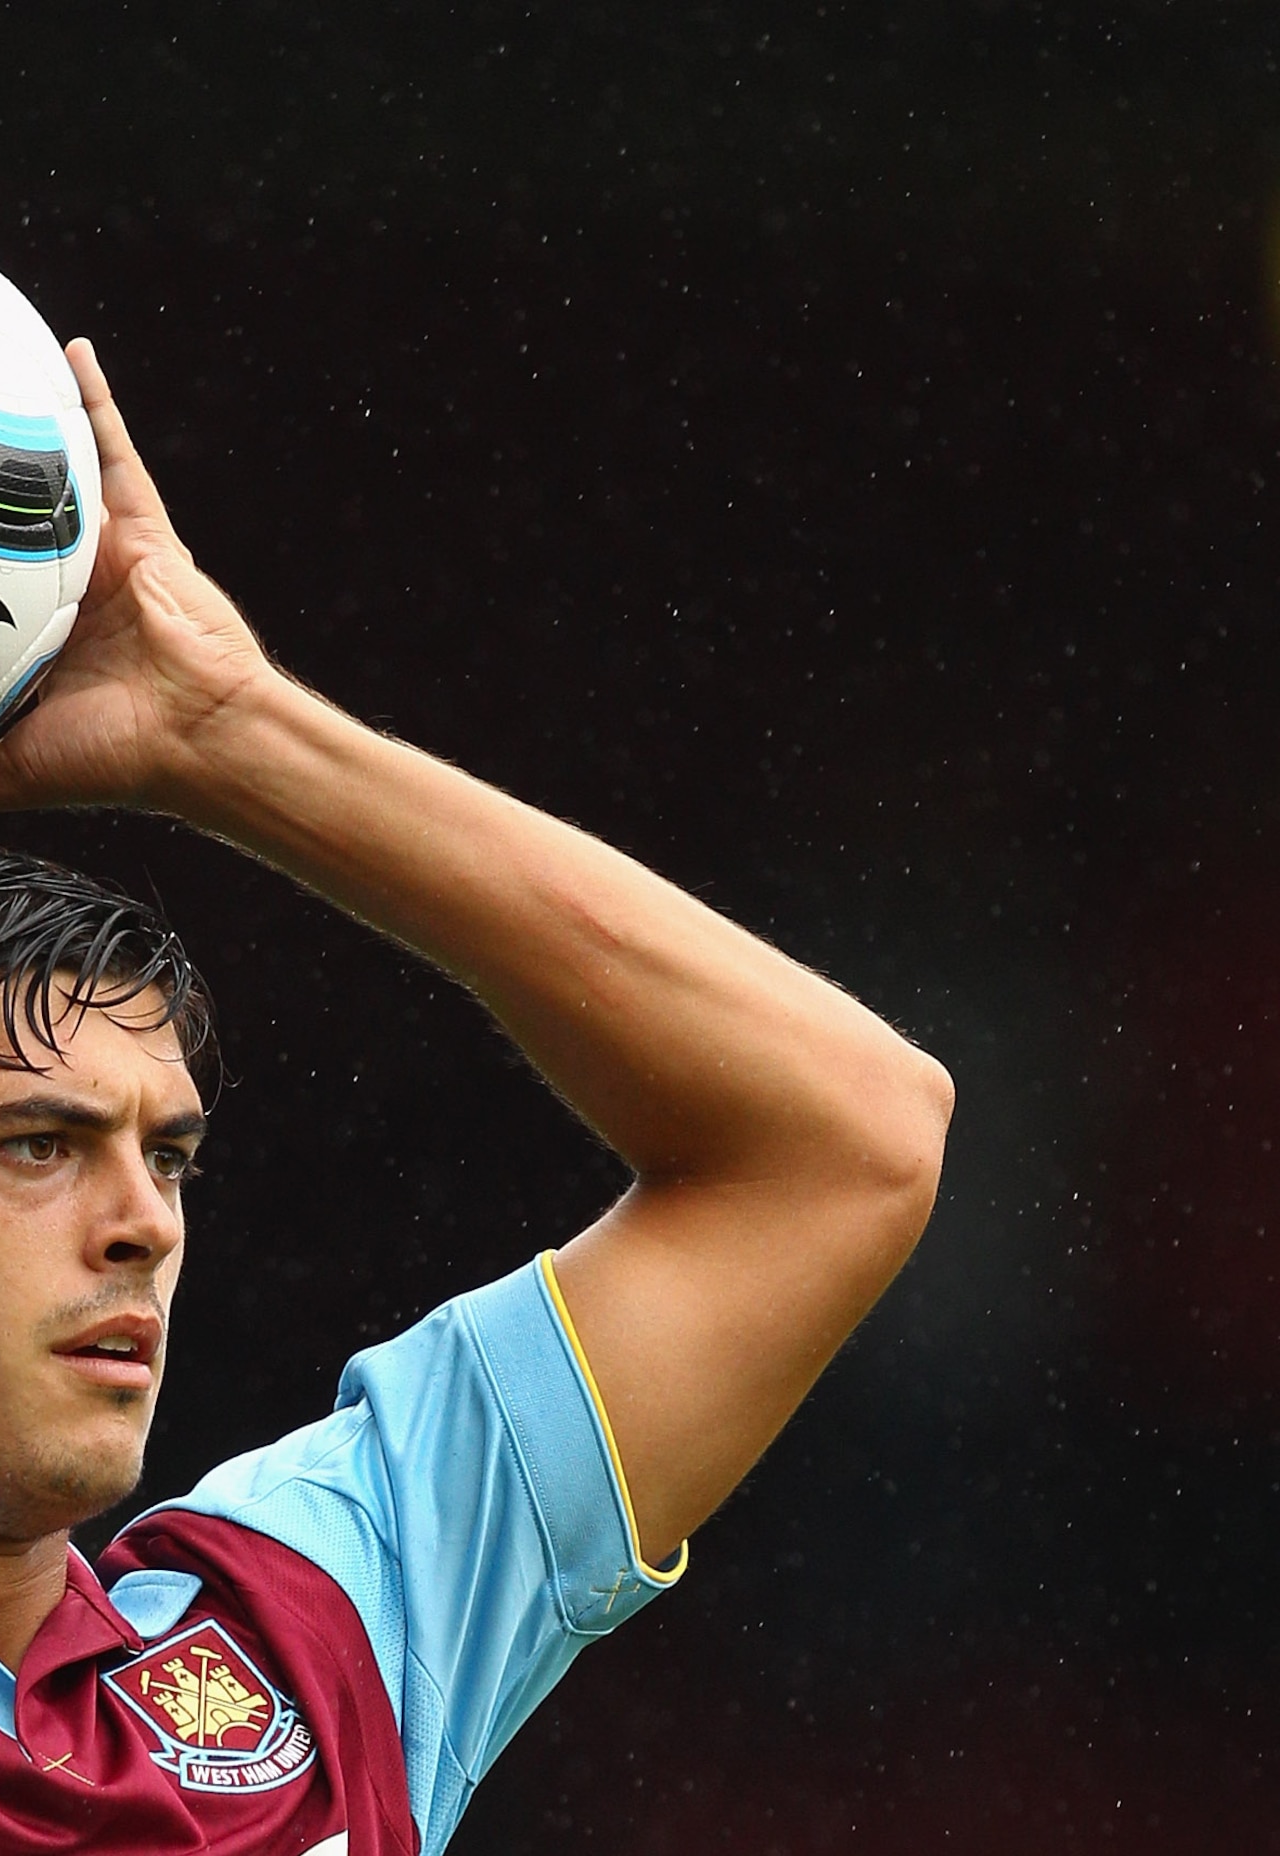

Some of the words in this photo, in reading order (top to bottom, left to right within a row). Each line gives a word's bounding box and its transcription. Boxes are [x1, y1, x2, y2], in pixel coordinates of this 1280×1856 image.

[191, 1764, 241, 1786] WEST
[241, 1759, 284, 1786] HAM
[273, 1723, 312, 1770] UNITED
